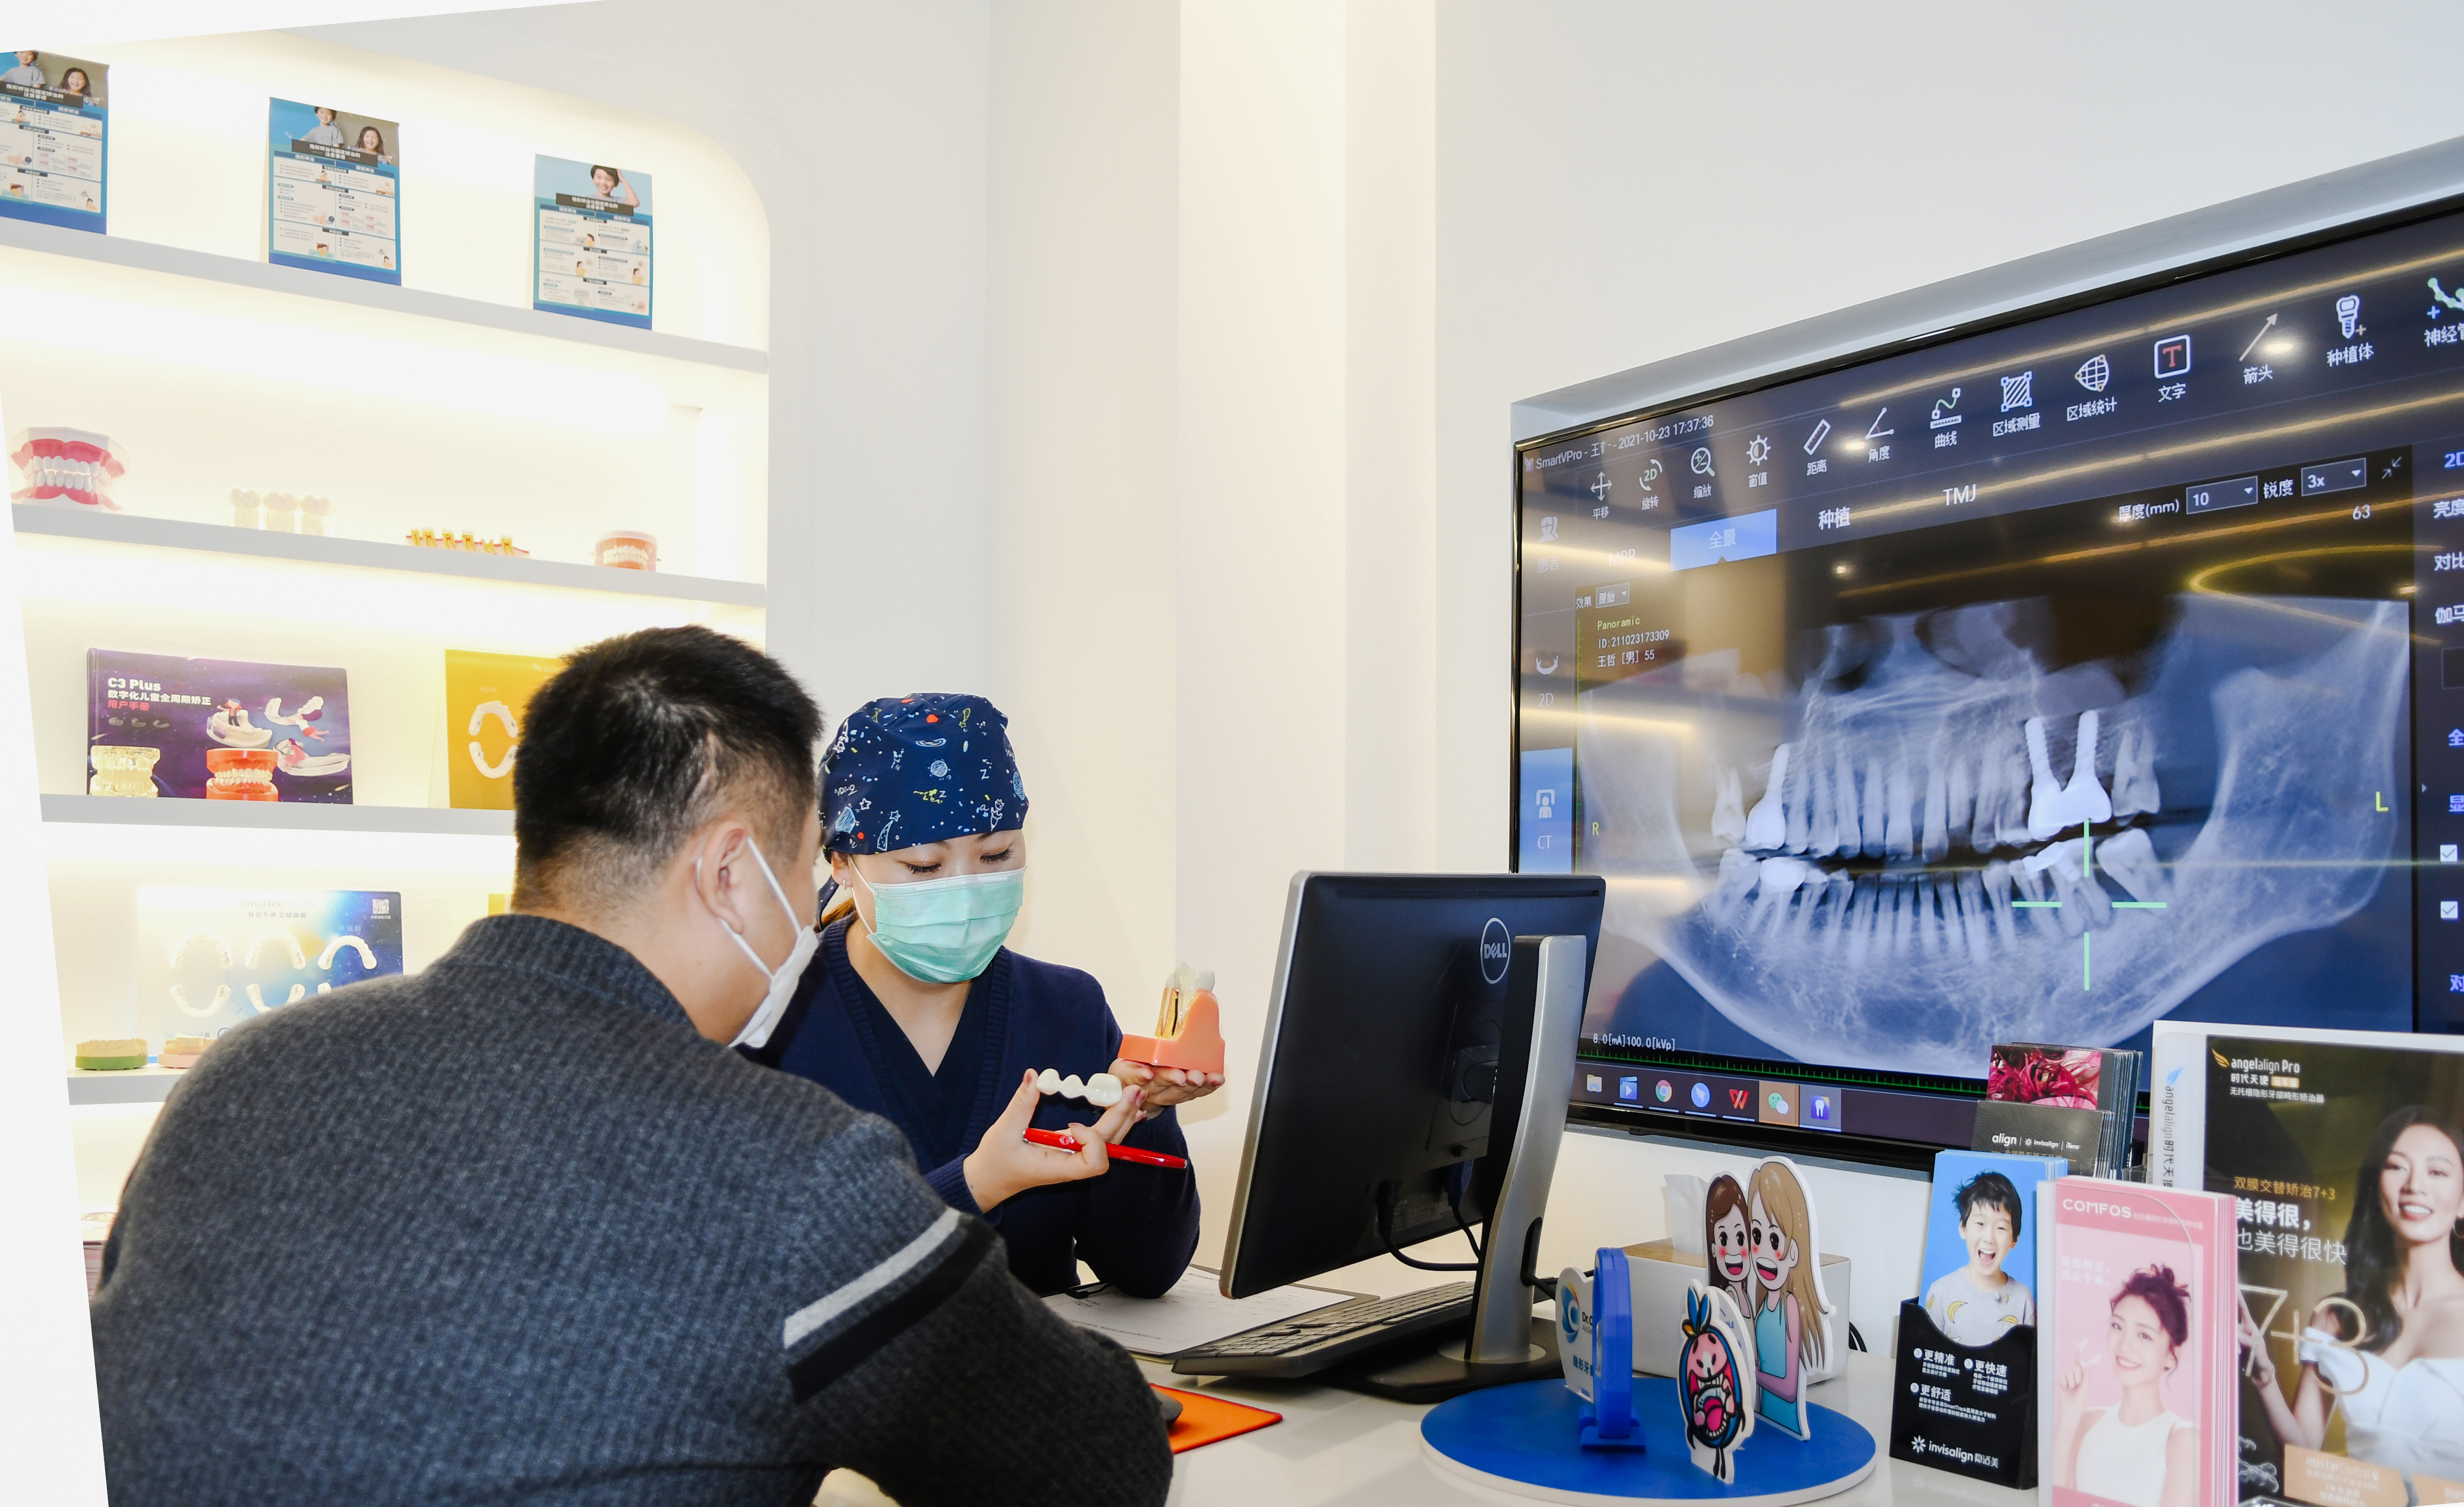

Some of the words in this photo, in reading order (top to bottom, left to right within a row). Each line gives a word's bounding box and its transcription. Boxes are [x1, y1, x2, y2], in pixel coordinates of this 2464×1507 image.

[2327, 342, 2375, 367] 种植体
[2243, 364, 2273, 385] 箭头
[2158, 382, 2186, 402] 文字
[2066, 396, 2117, 421] 区域统计
[1993, 412, 2041, 437] 区域测量
[1536, 449, 1582, 470] SmartVPro
[1618, 425, 1670, 450] 2021-10-23
[1673, 414, 1714, 436] 17:37:36
[1935, 430, 1957, 448] 曲线
[1868, 445, 1890, 463] 角度
[1806, 459, 1827, 476] 距离
[1693, 484, 1711, 498] 缩放
[1942, 484, 1977, 506] TMJ
[2119, 499, 2180, 523] 厚度(mm)
[2192, 492, 2209, 506] 10
[2263, 479, 2294, 499] 锐度
[2307, 474, 2325, 489] 3x
[1642, 495, 1659, 510] 旋转
[1593, 506, 1609, 519] 平移
[1818, 506, 1851, 530] 种植
[2352, 504, 2371, 521] 63
[1709, 528, 1736, 548] 全景
[1608, 548, 1636, 567] MPR
[1575, 596, 1592, 609] 效果
[1598, 591, 1615, 604] 原始
[1598, 616, 1640, 631] Panoramic
[1598, 629, 1670, 649] ID:211023173309
[1598, 654, 1616, 668] 王哲
[1644, 649, 1655, 660] 55
[108, 677, 126, 689] C3
[130, 679, 161, 691] Plus
[107, 689, 212, 706] 数字化儿童全周期矫正
[107, 699, 150, 711] 用户手册
[1538, 692, 1554, 708] 2D
[2376, 791, 2389, 812] L
[1592, 822, 1599, 836] R
[1537, 834, 1552, 850] CT
[239, 899, 284, 908] Smartee
[1484, 942, 1507, 959] DELL
[2231, 1057, 2280, 1074] angelalign
[2281, 1059, 2300, 1073] Pro
[2231, 1073, 2269, 1085] 时代天使
[2230, 1087, 2325, 1103] 无托槽隐形牙颌畸形矫治器
[2161, 1085, 2175, 1139] angelalign
[1992, 1133, 2017, 1146] align
[2034, 1139, 2059, 1148] invisalign
[2066, 1141, 2080, 1150] iTero
[2234, 1176, 2336, 1201] 双膜交替矫治7+3
[2063, 1198, 2131, 1218] COMFOS
[2236, 1227, 2347, 1266] 也美得很快
[1923, 1349, 1955, 1366] 更精准
[1974, 1359, 2007, 1377] 更快速
[1920, 1384, 1952, 1401] 更舒适
[1929, 1440, 1973, 1463] invisalign
[1974, 1452, 1999, 1468] 隐适美
